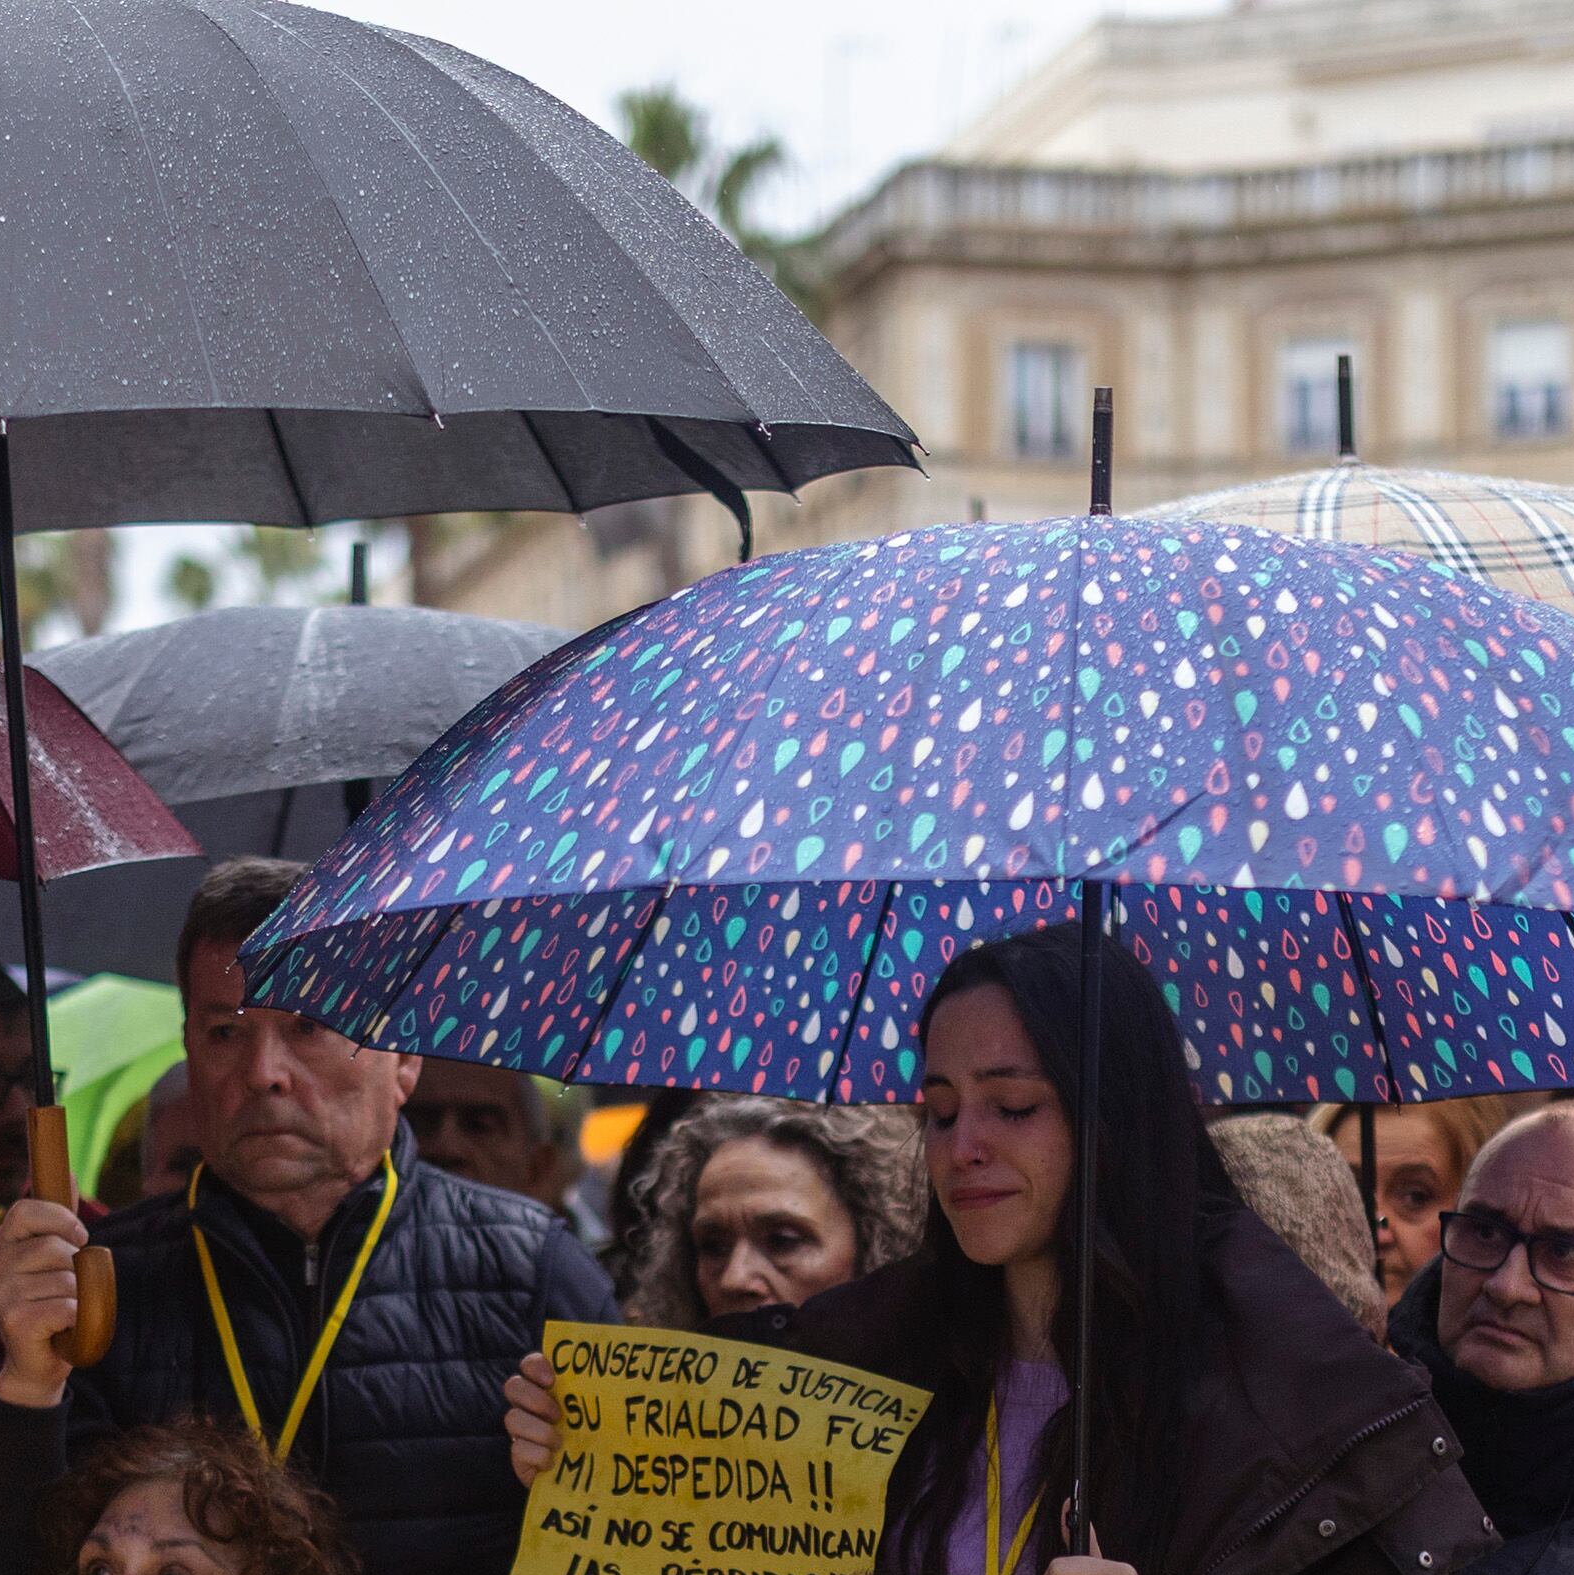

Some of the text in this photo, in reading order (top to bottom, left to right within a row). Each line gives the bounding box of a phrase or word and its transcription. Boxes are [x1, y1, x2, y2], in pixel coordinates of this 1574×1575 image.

[553, 1340, 719, 1385] CONSEJERO
[732, 1358, 770, 1390] DE
[564, 1394, 906, 1455] SU FRIALDAD FUE
[555, 1451, 595, 1493] MI
[612, 1454, 793, 1504] DESPEDIDA
[540, 1504, 877, 1559] ASÍ NO SE COMUNICAN
